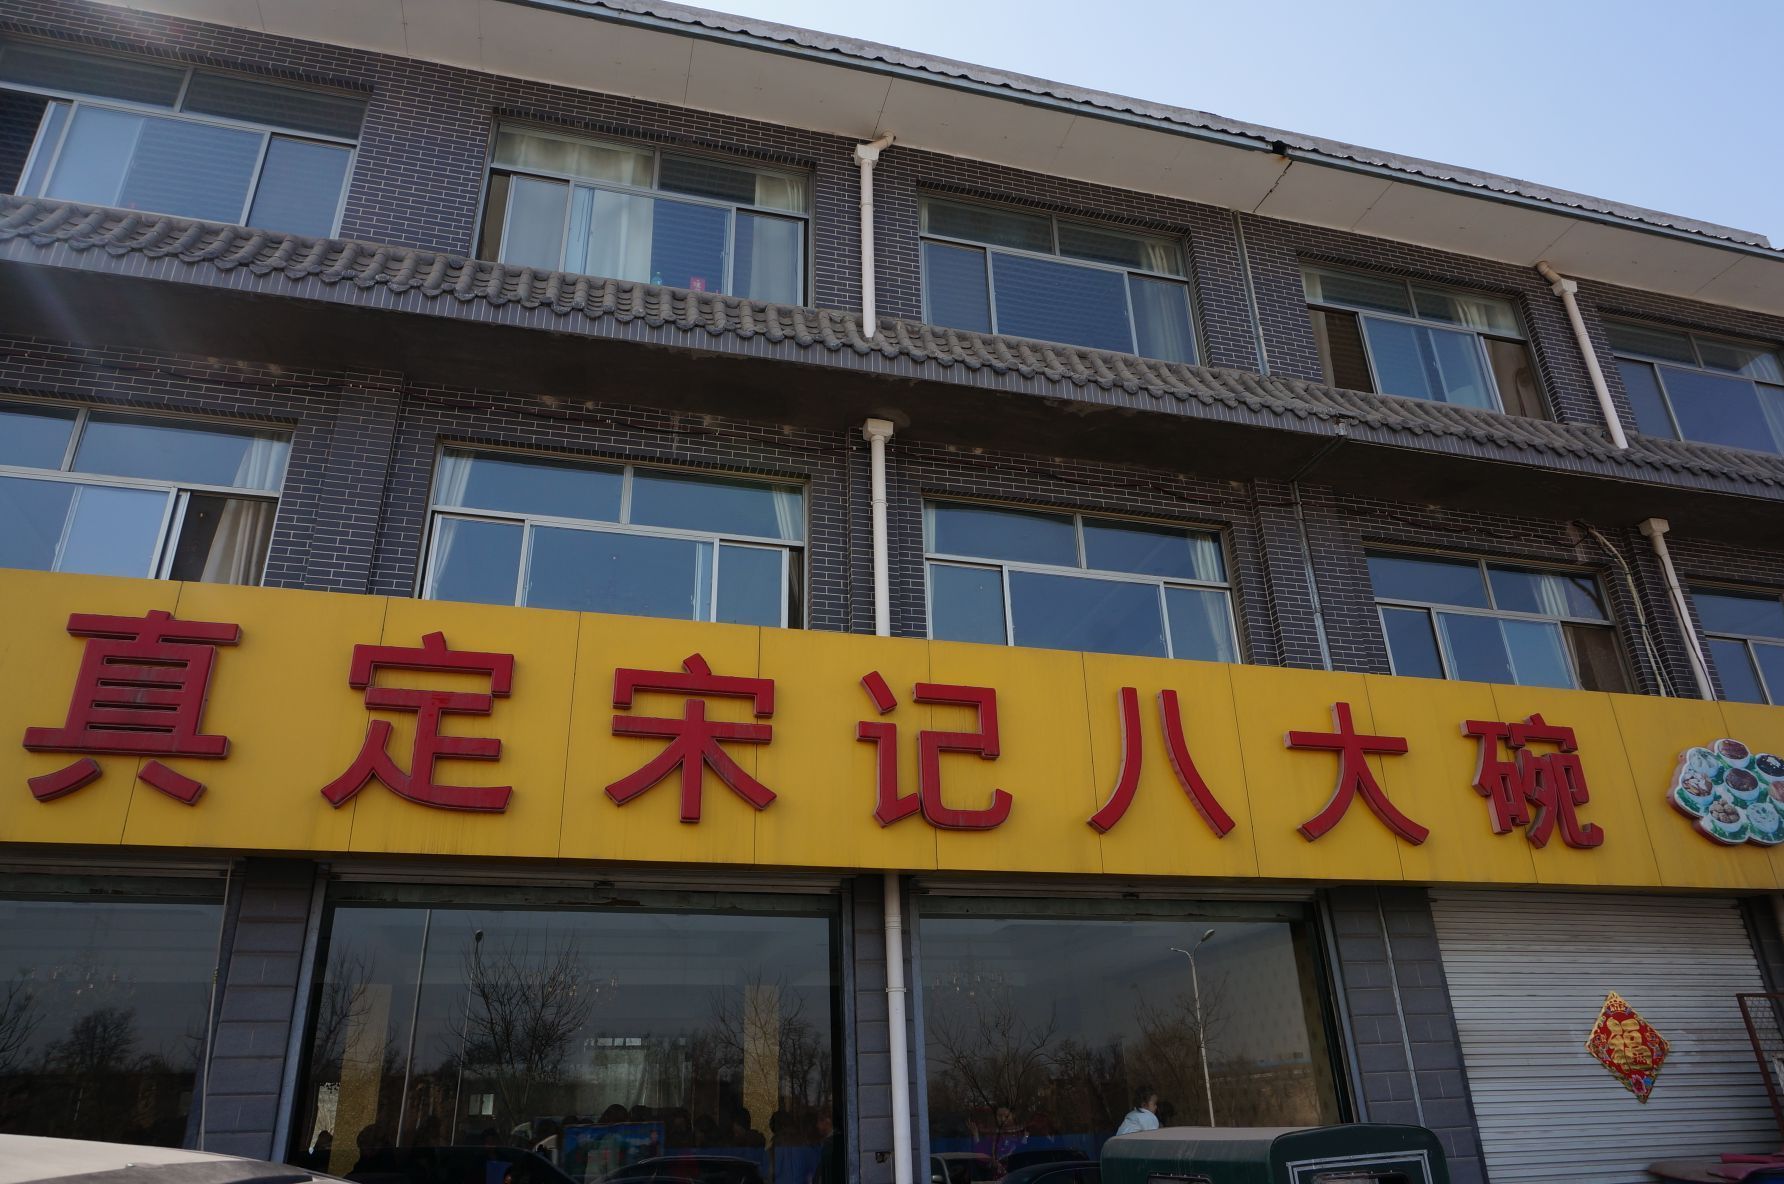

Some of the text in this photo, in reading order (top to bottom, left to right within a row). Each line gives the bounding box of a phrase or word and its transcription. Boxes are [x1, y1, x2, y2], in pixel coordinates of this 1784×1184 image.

[23, 609, 1605, 850] 真定宋记八大碗
[1606, 1016, 1653, 1072] 福
